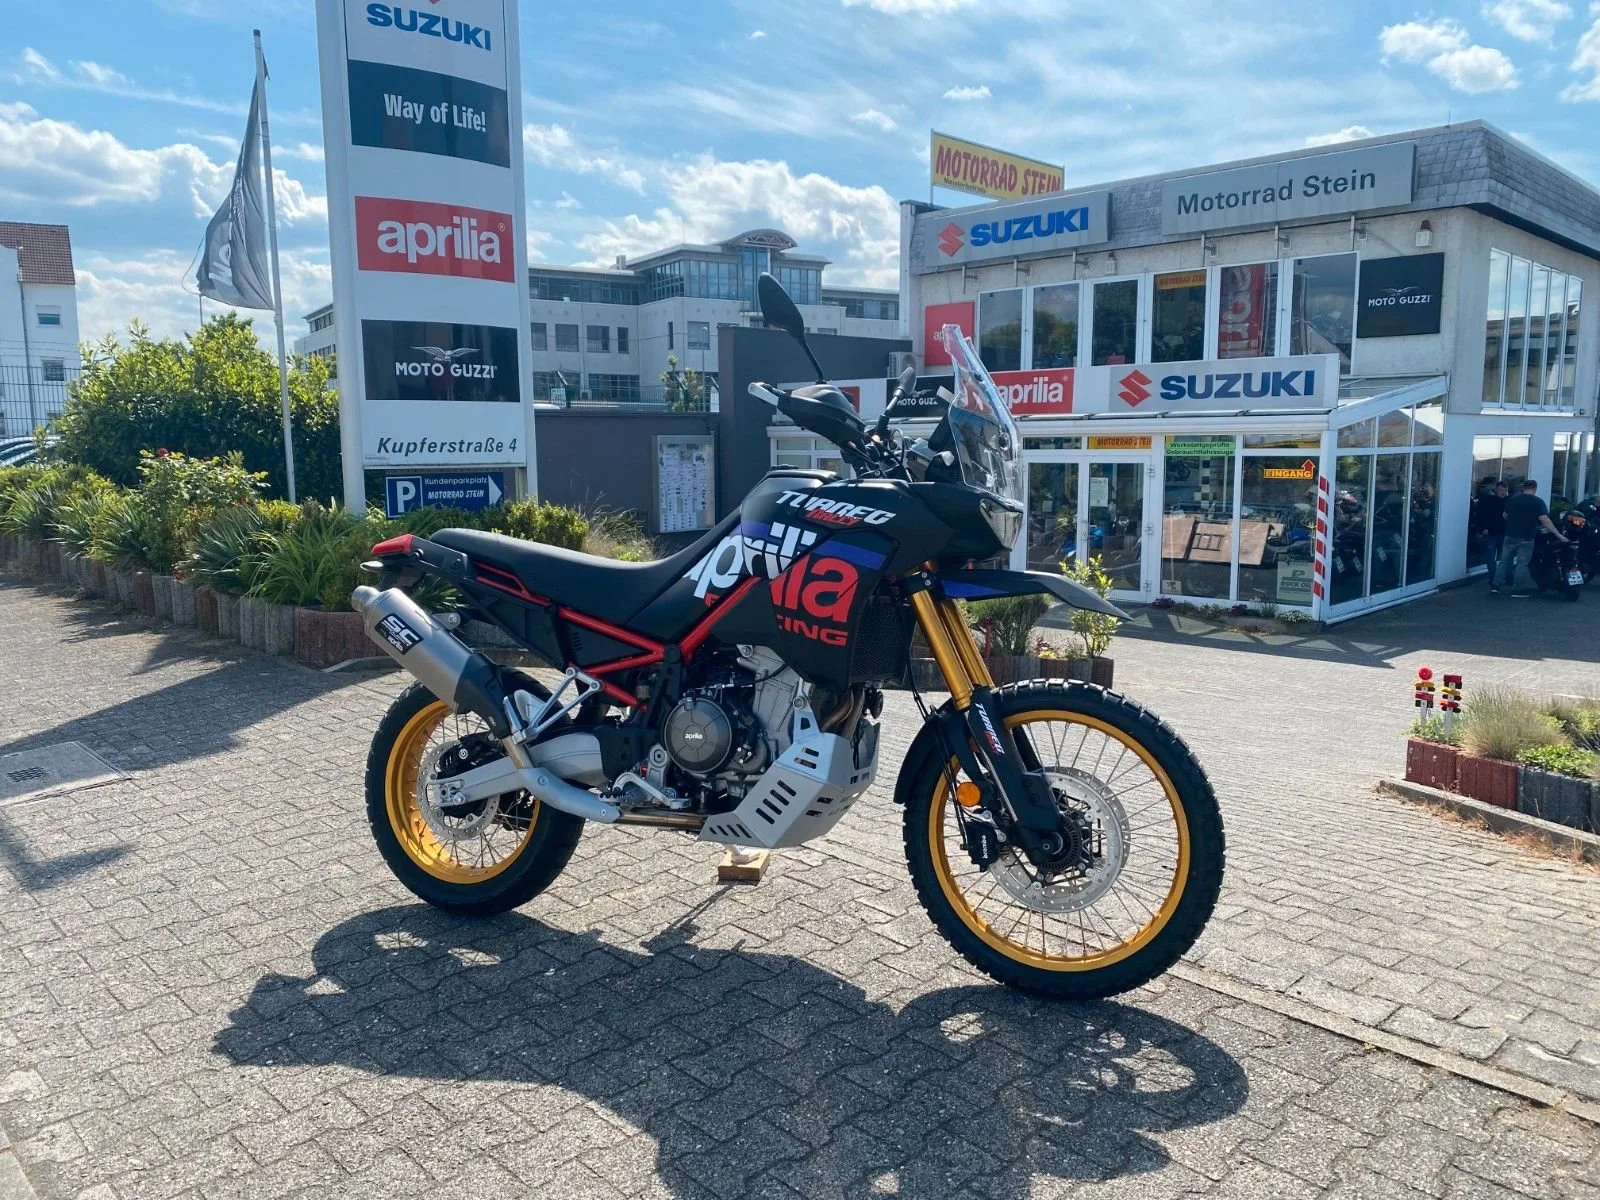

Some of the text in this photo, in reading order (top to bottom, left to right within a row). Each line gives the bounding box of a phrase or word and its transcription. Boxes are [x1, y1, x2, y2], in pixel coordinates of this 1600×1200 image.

[367, 3, 491, 51] SUZUKI
[384, 94, 486, 132] Way of Life!
[936, 144, 1062, 195] MOTORRAD STEIN
[1177, 169, 1376, 215] Motorrad Stein
[377, 215, 501, 264] aprilia
[970, 206, 1089, 247] SUZUKI
[1368, 294, 1430, 307] MOTO GUZZI
[395, 361, 495, 379] MOTO GUZZI
[997, 376, 1064, 409] aprilia
[1160, 370, 1315, 401] SUZUKI
[377, 437, 517, 456] Kupferstraße 4
[1097, 437, 1133, 446] MOTORRAD
[425, 476, 487, 485] Kundenparkplatz
[1265, 470, 1311, 478] EINGANG
[396, 480, 416, 513] P
[428, 489, 485, 499] MOTORRAD STEIN
[387, 615, 420, 641] SC
[684, 732, 703, 740] aprilia
